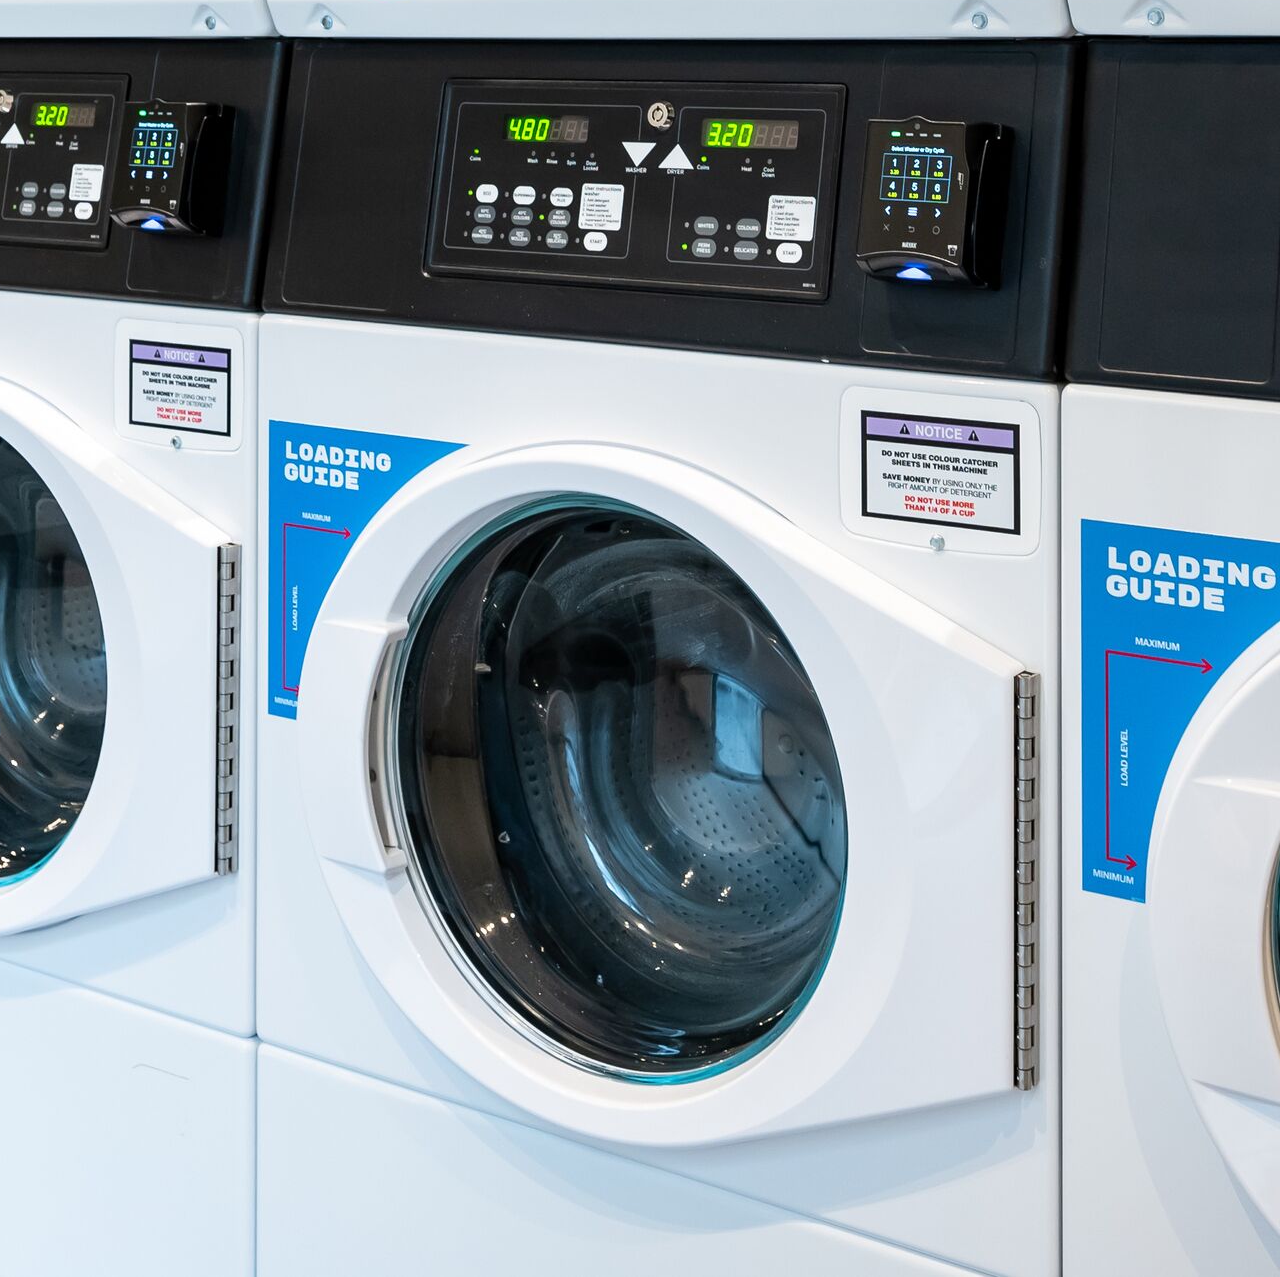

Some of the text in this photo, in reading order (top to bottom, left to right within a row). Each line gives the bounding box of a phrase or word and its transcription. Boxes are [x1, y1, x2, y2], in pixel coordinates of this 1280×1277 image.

[36, 106, 68, 126] 3.20
[510, 119, 550, 141] 4.80
[708, 123, 753, 147] 3.20
[625, 166, 648, 174] WASHER
[665, 167, 687, 175] DRYER
[164, 350, 195, 362] NOTICE
[915, 425, 963, 440] NOTICE
[285, 441, 391, 473] LOADING
[285, 462, 359, 490] GUIDE
[302, 512, 331, 522] MAXIMUM
[1106, 547, 1276, 595] LOADING
[1106, 569, 1224, 612] GUIDE
[1135, 637, 1180, 651] MAXIMUM
[1120, 729, 1128, 758] LEVEL
[1093, 868, 1134, 884] MINIMUM
